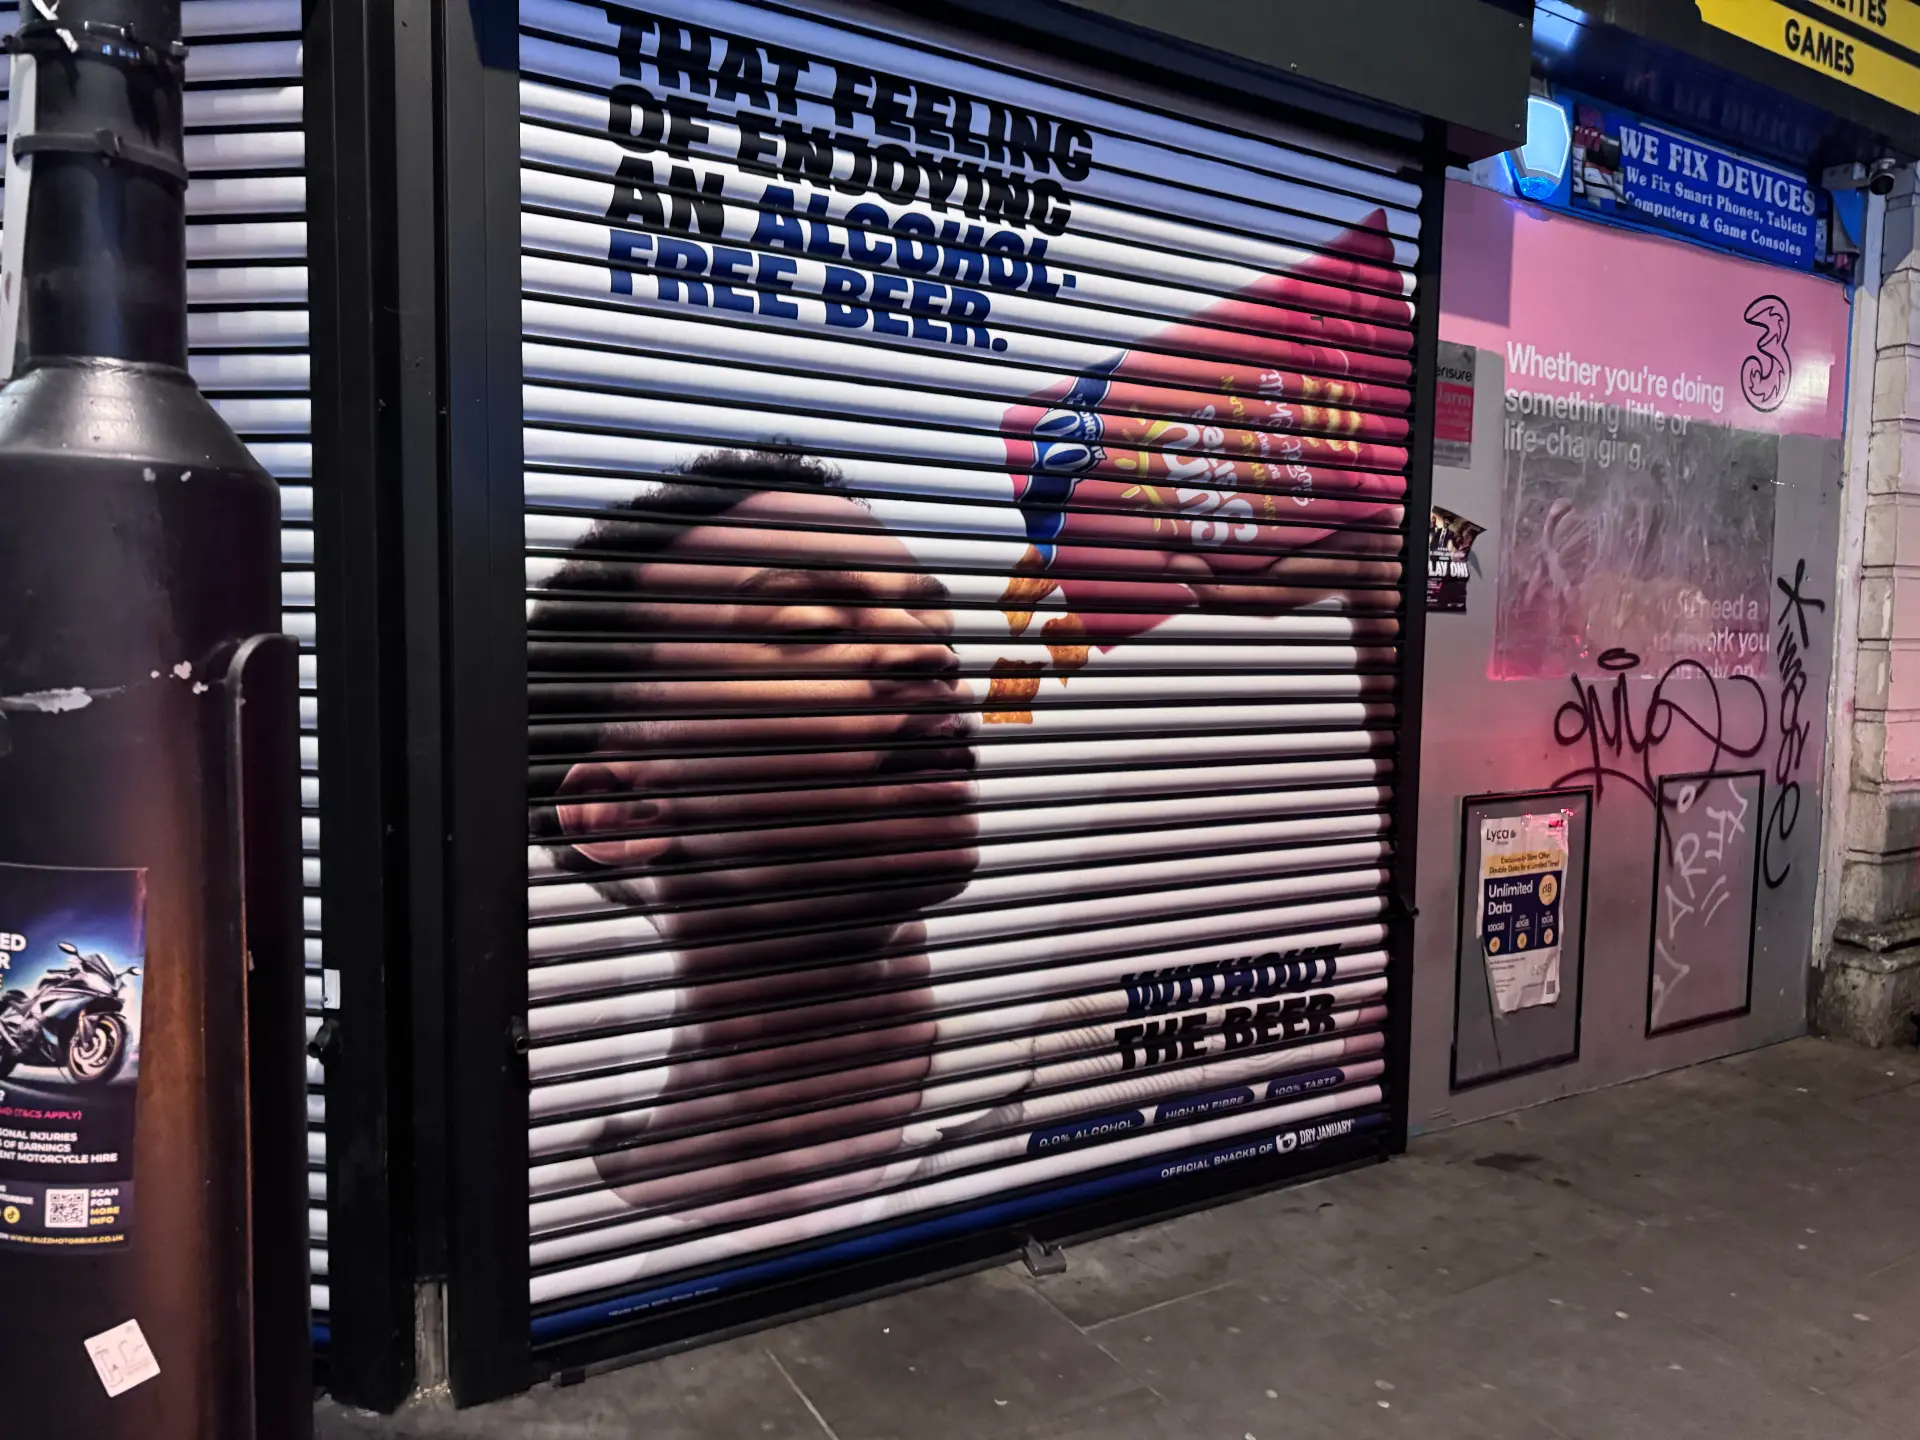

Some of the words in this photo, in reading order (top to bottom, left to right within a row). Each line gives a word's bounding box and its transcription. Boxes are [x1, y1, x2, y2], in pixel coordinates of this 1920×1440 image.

[1785, 18, 1854, 76] GAMES
[606, 8, 809, 115] THAT
[834, 67, 1092, 181] FEELING
[609, 84, 710, 160] OF
[737, 111, 1071, 236] ENJOYING
[1619, 125, 1659, 166] WE
[1668, 143, 1708, 182] FIX
[1717, 159, 1815, 217] DEVICES
[605, 157, 724, 238] AN
[1626, 166, 1647, 186] We
[1652, 175, 1670, 194] Fix
[1674, 181, 1712, 207] Smart
[1717, 194, 1764, 224] Phones,
[1767, 210, 1808, 237] Tablets
[1625, 191, 1695, 225] Computers
[1699, 212, 1710, 229] &
[1713, 218, 1747, 241] Game
[1751, 229, 1801, 257] Consoles
[608, 228, 798, 320] FREE
[825, 266, 1008, 352] BEER.
[1506, 341, 1600, 387] Whether
[1604, 366, 1667, 397] you're
[1671, 372, 1724, 413] doing
[1504, 388, 1620, 433] something
[1626, 398, 1665, 433] little
[1670, 413, 1691, 435] or
[1747, 599, 1759, 620] a
[1738, 631, 1770, 658] you
[1486, 829, 1509, 842] Lyca
[1488, 880, 1534, 898] Unlimited
[1488, 901, 1512, 915] Data
[1114, 1012, 1208, 1071] THE
[1224, 993, 1335, 1051] BEER
[1274, 1084, 1301, 1096] 100%
[1304, 1076, 1337, 1090] TASTE
[44, 1110, 83, 1121] APPLY)
[1164, 1106, 1194, 1120] HIGH
[1197, 1103, 1209, 1113] IN
[1211, 1095, 1245, 1110] FIBRE
[30, 1131, 78, 1142] INJURIES
[1074, 1119, 1134, 1140] ALCOHOL
[3, 1140, 16, 1149] OF
[17, 1142, 72, 1153] EARNINGS
[17, 1152, 89, 1164] MOTORCYCLE
[90, 1152, 119, 1163] HIRE
[1160, 1158, 1210, 1178] OFFICIAL
[1213, 1146, 1257, 1166] SNACKS
[1259, 1143, 1273, 1155] OF
[1299, 1128, 1316, 1145] DRY
[1316, 1120, 1352, 1142] JANUARY
[90, 1187, 119, 1198] SCAN
[90, 1197, 112, 1207] FOR
[90, 1206, 120, 1216] MORE
[90, 1215, 115, 1226] INFO
